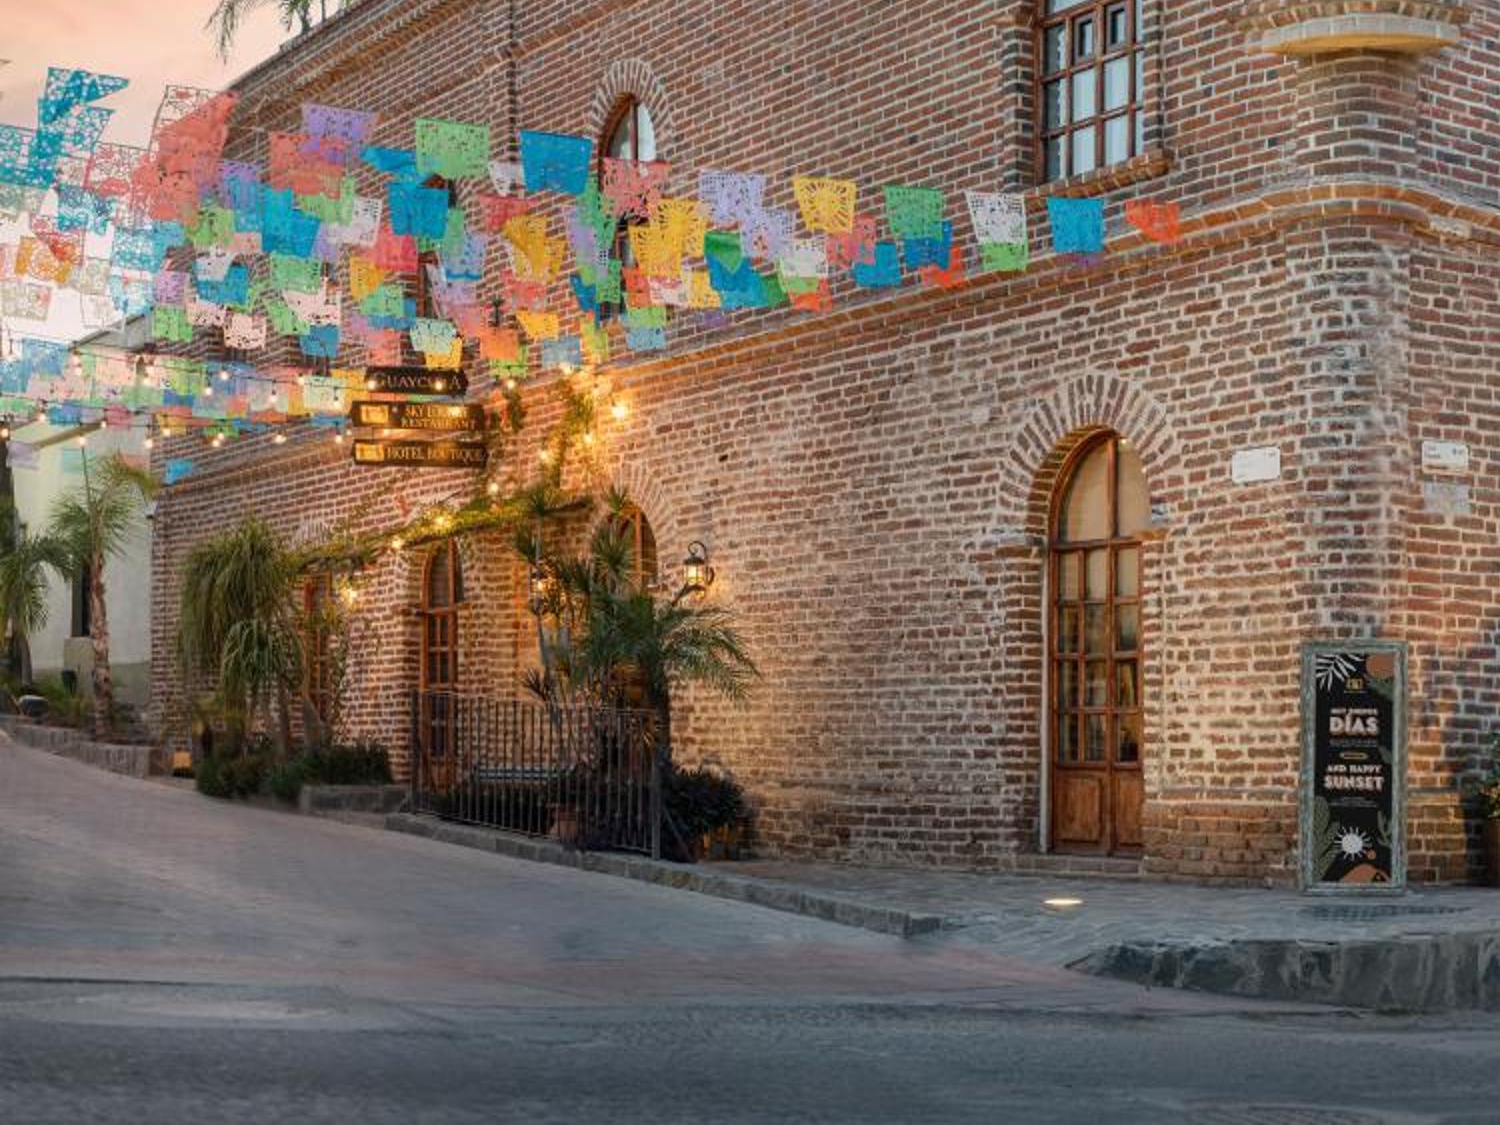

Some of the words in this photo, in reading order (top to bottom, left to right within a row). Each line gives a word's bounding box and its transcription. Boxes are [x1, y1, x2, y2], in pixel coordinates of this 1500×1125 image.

[405, 404, 425, 417] SKY
[400, 417, 476, 430] RESTAURANT
[387, 446, 424, 460] HOTEL
[1329, 714, 1379, 735] DÍAS
[1349, 764, 1382, 773] HAPPY
[1324, 775, 1384, 791] SUNSET
